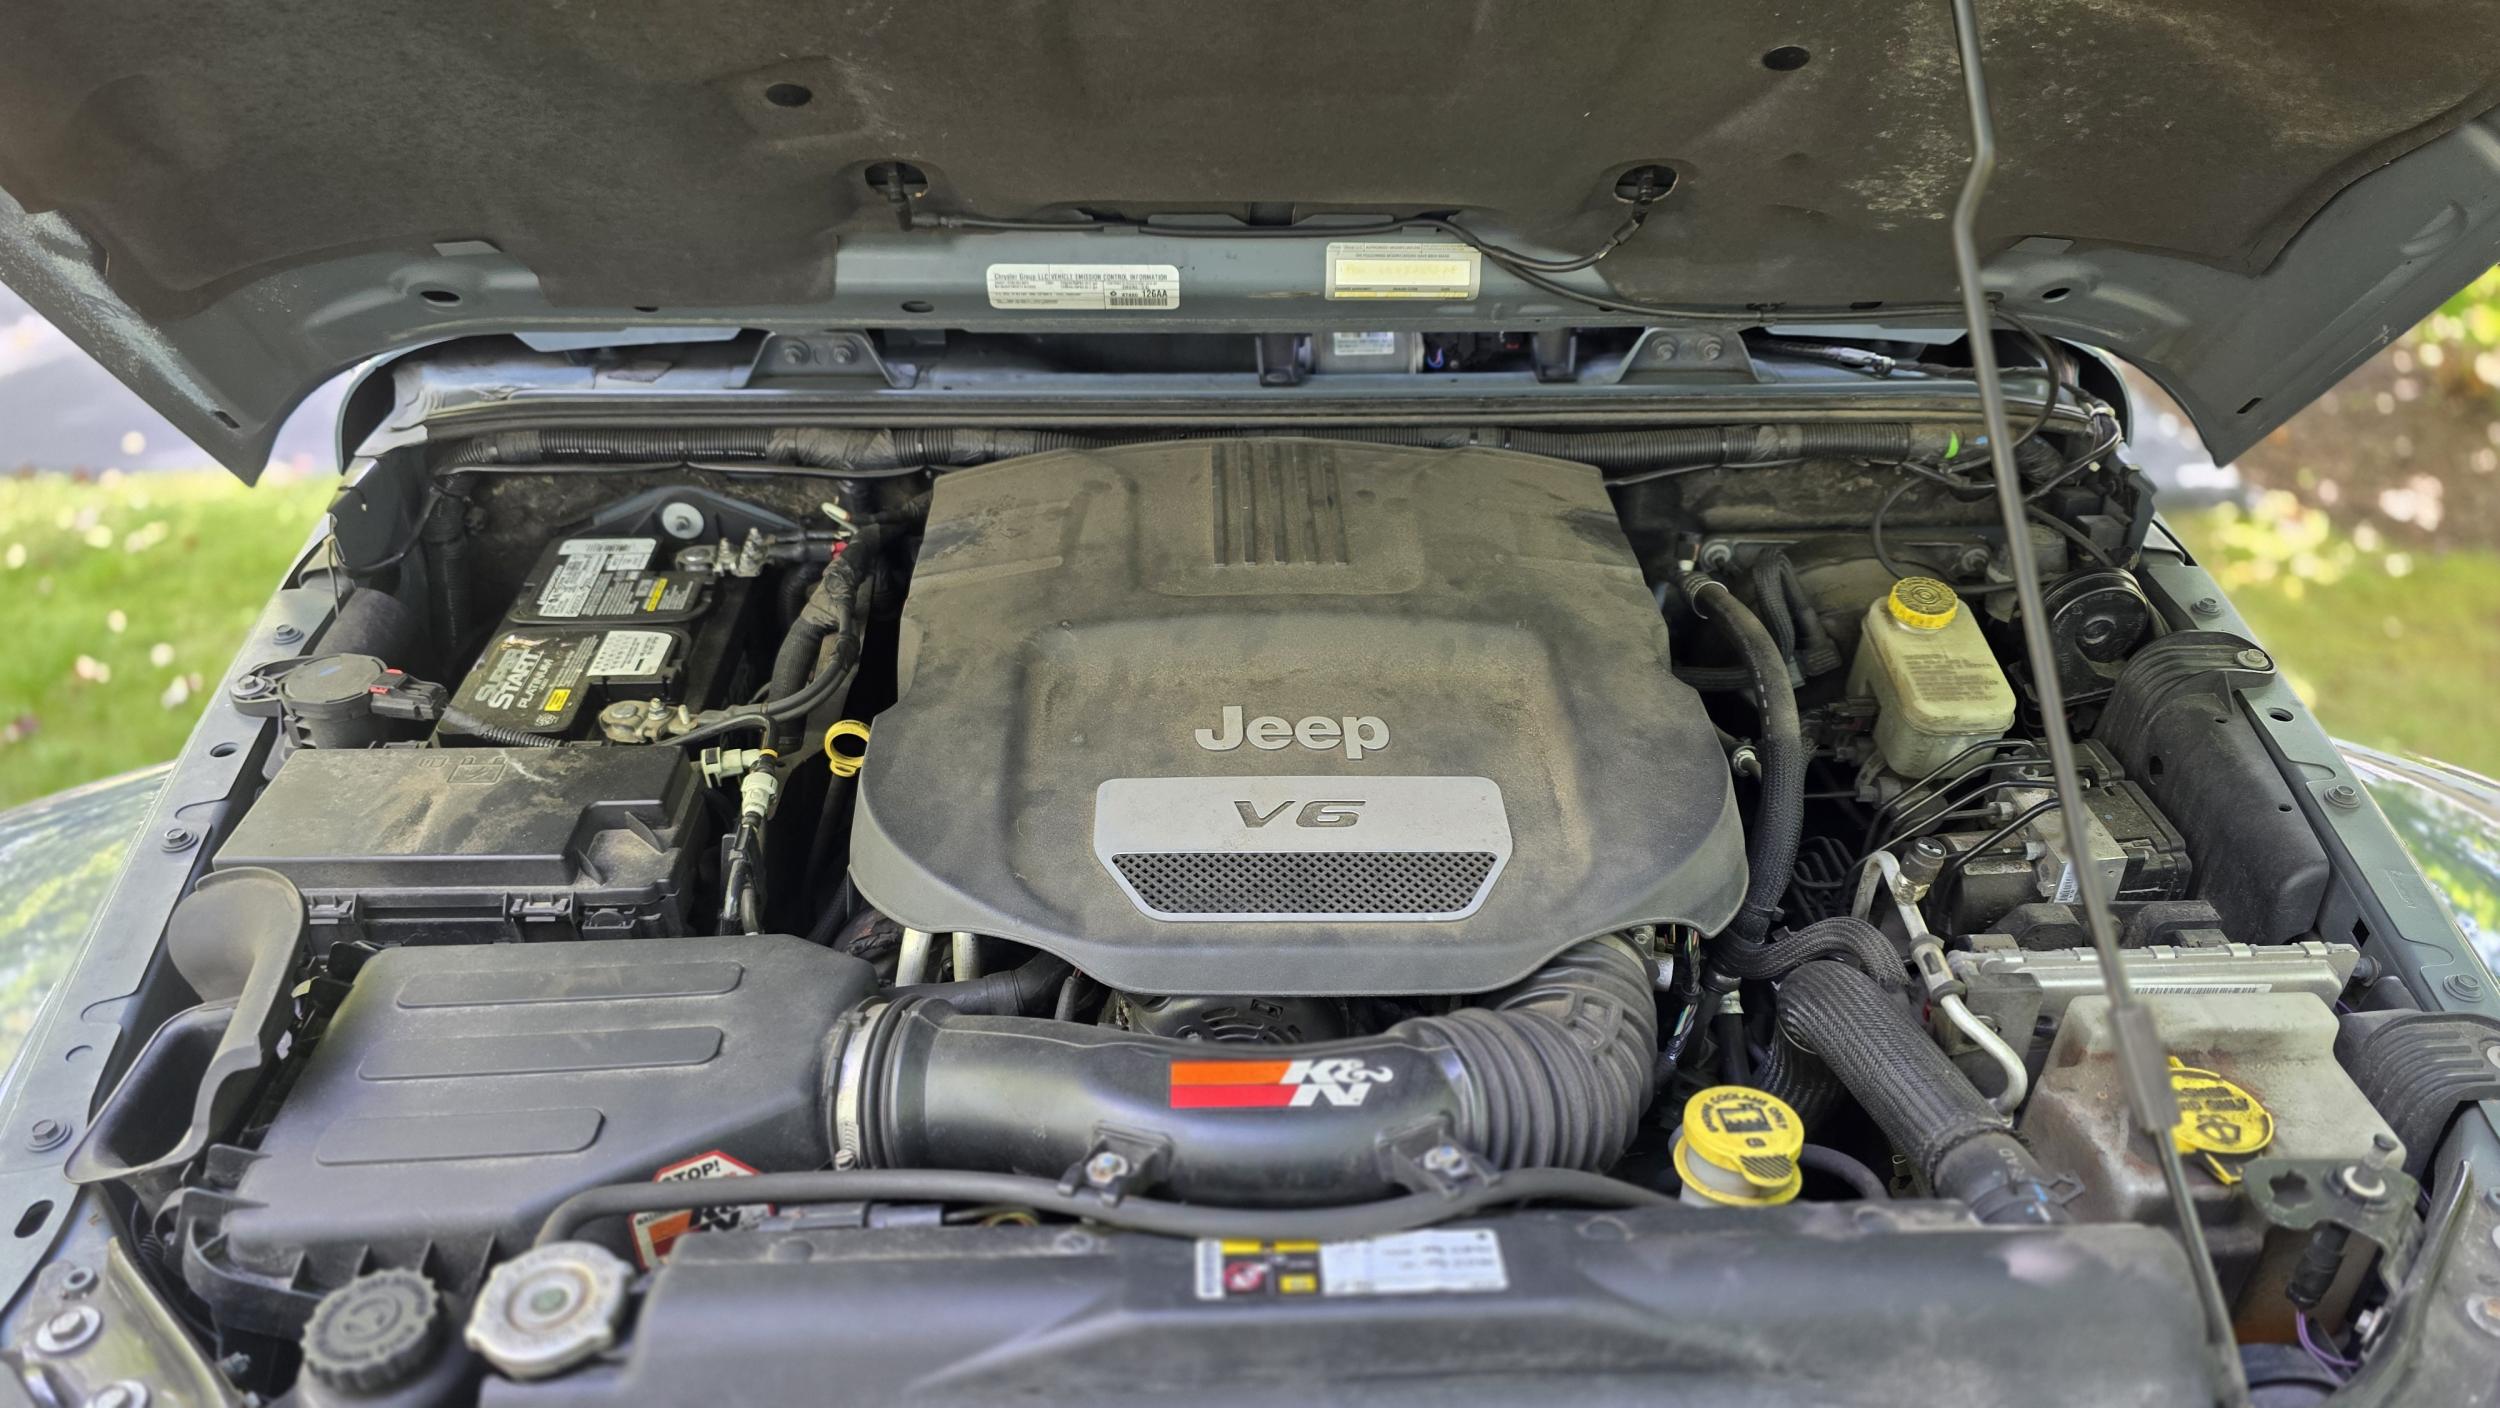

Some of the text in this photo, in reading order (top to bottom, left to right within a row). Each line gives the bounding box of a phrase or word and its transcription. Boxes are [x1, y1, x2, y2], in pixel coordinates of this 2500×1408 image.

[1075, 273, 1101, 281] EMISSION
[1103, 273, 1127, 281] CONTROL
[1129, 273, 1168, 281] INFORMATION
[487, 648, 541, 710] START
[516, 659, 554, 709] PLATINUM
[1194, 705, 1391, 760] Jeep
[1234, 800, 1367, 828] V6
[1280, 1058, 1394, 1107] K&N
